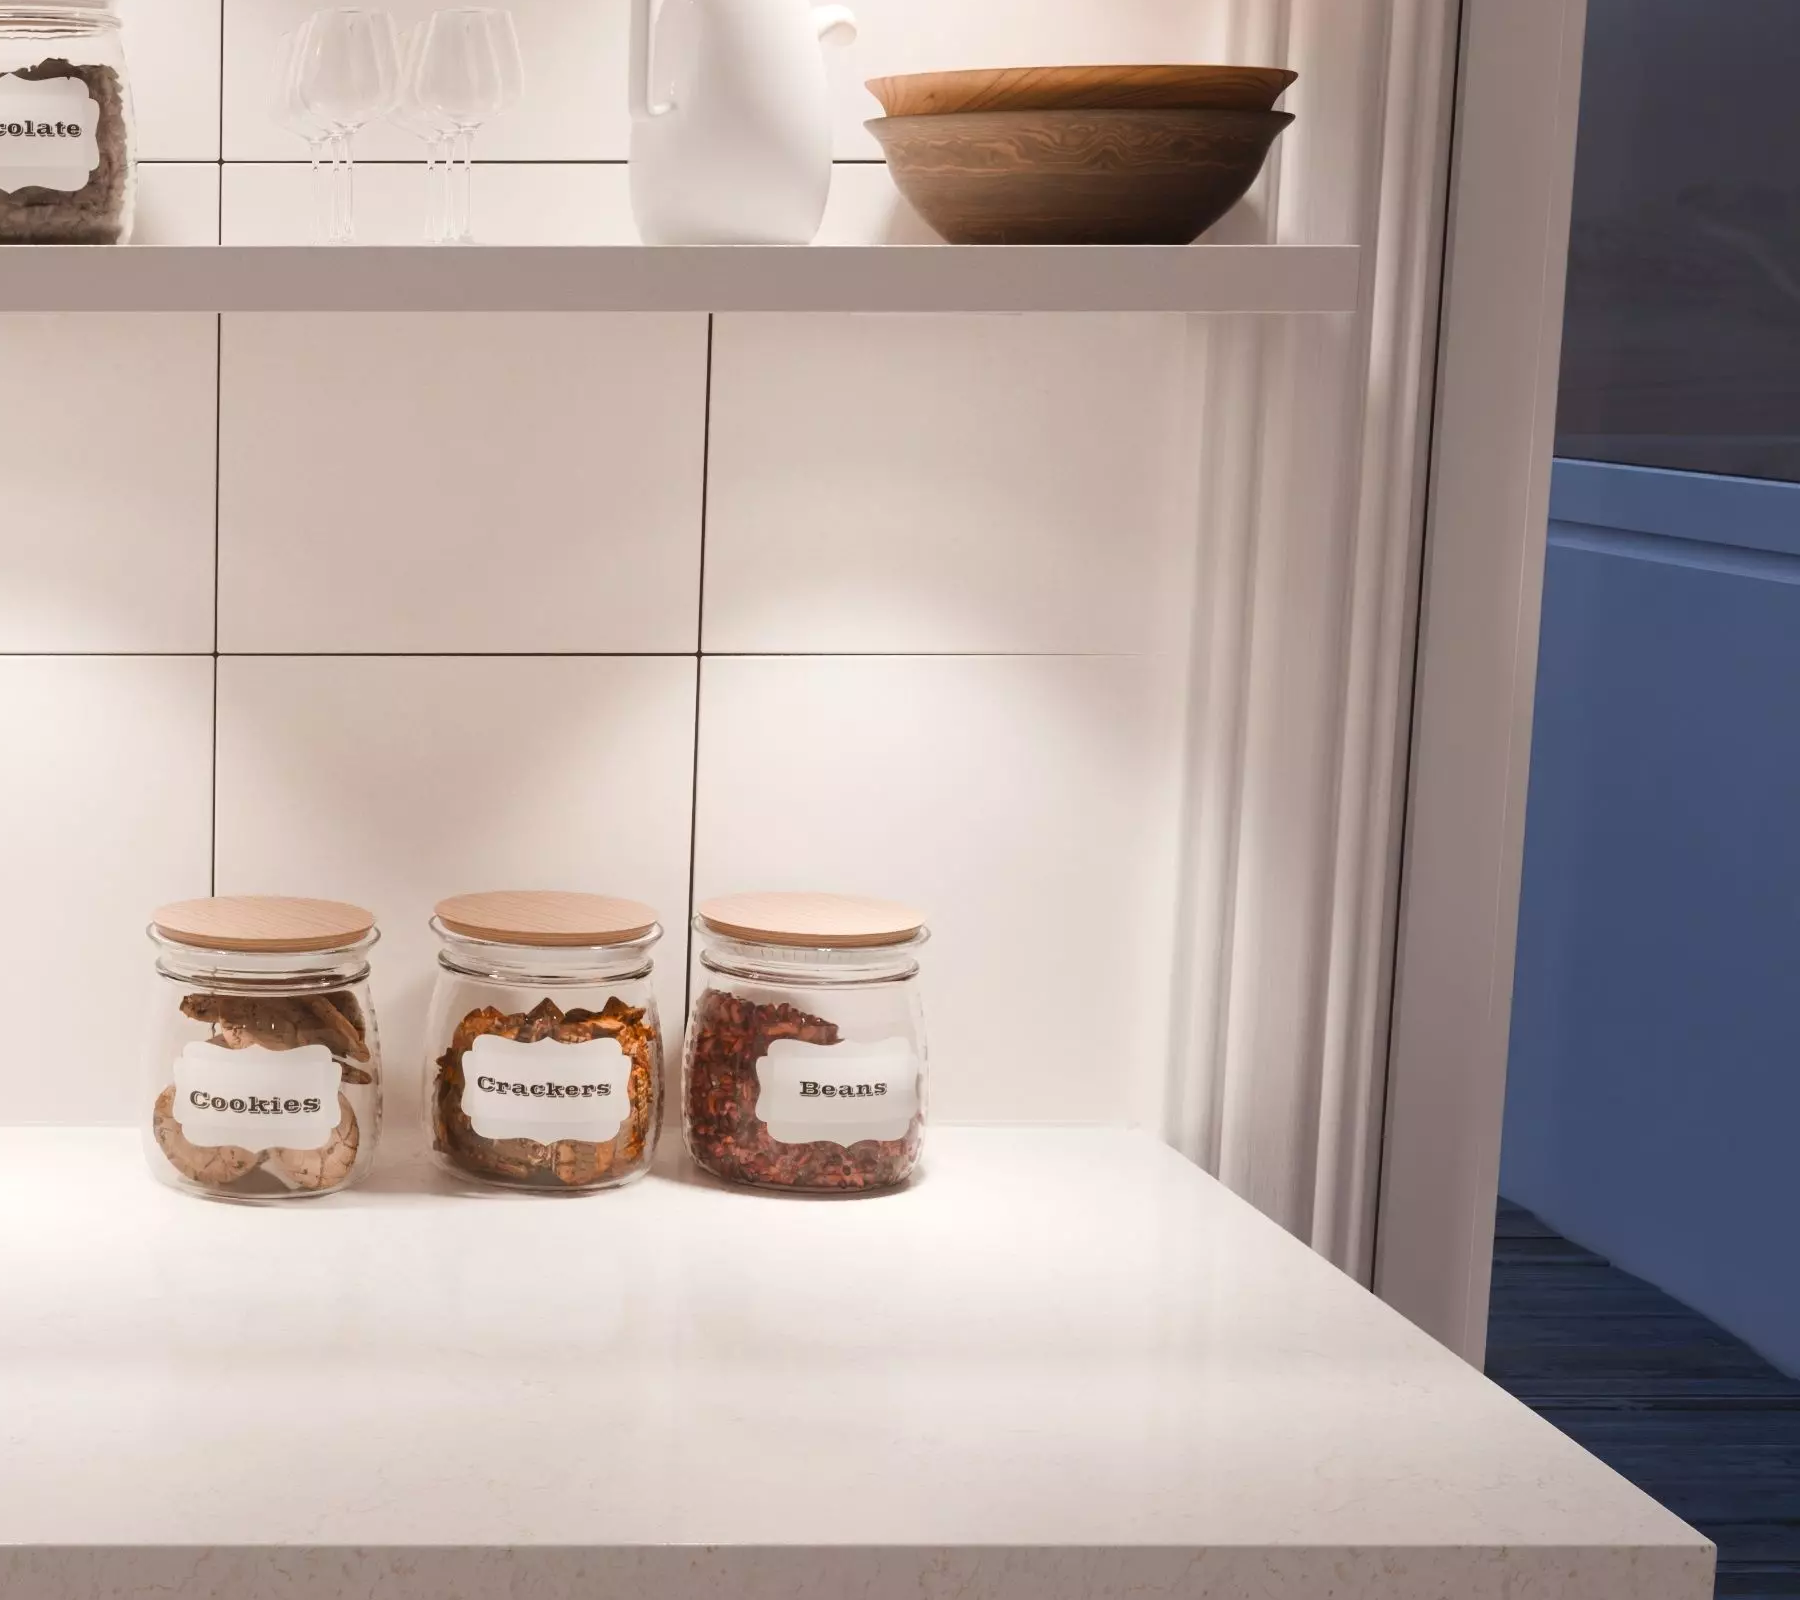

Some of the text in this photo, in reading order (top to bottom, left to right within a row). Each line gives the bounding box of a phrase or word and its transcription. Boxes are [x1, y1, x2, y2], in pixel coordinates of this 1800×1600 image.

[476, 1075, 612, 1099] Crackers
[799, 1080, 888, 1100] Beans
[189, 1090, 321, 1115] Cookies
